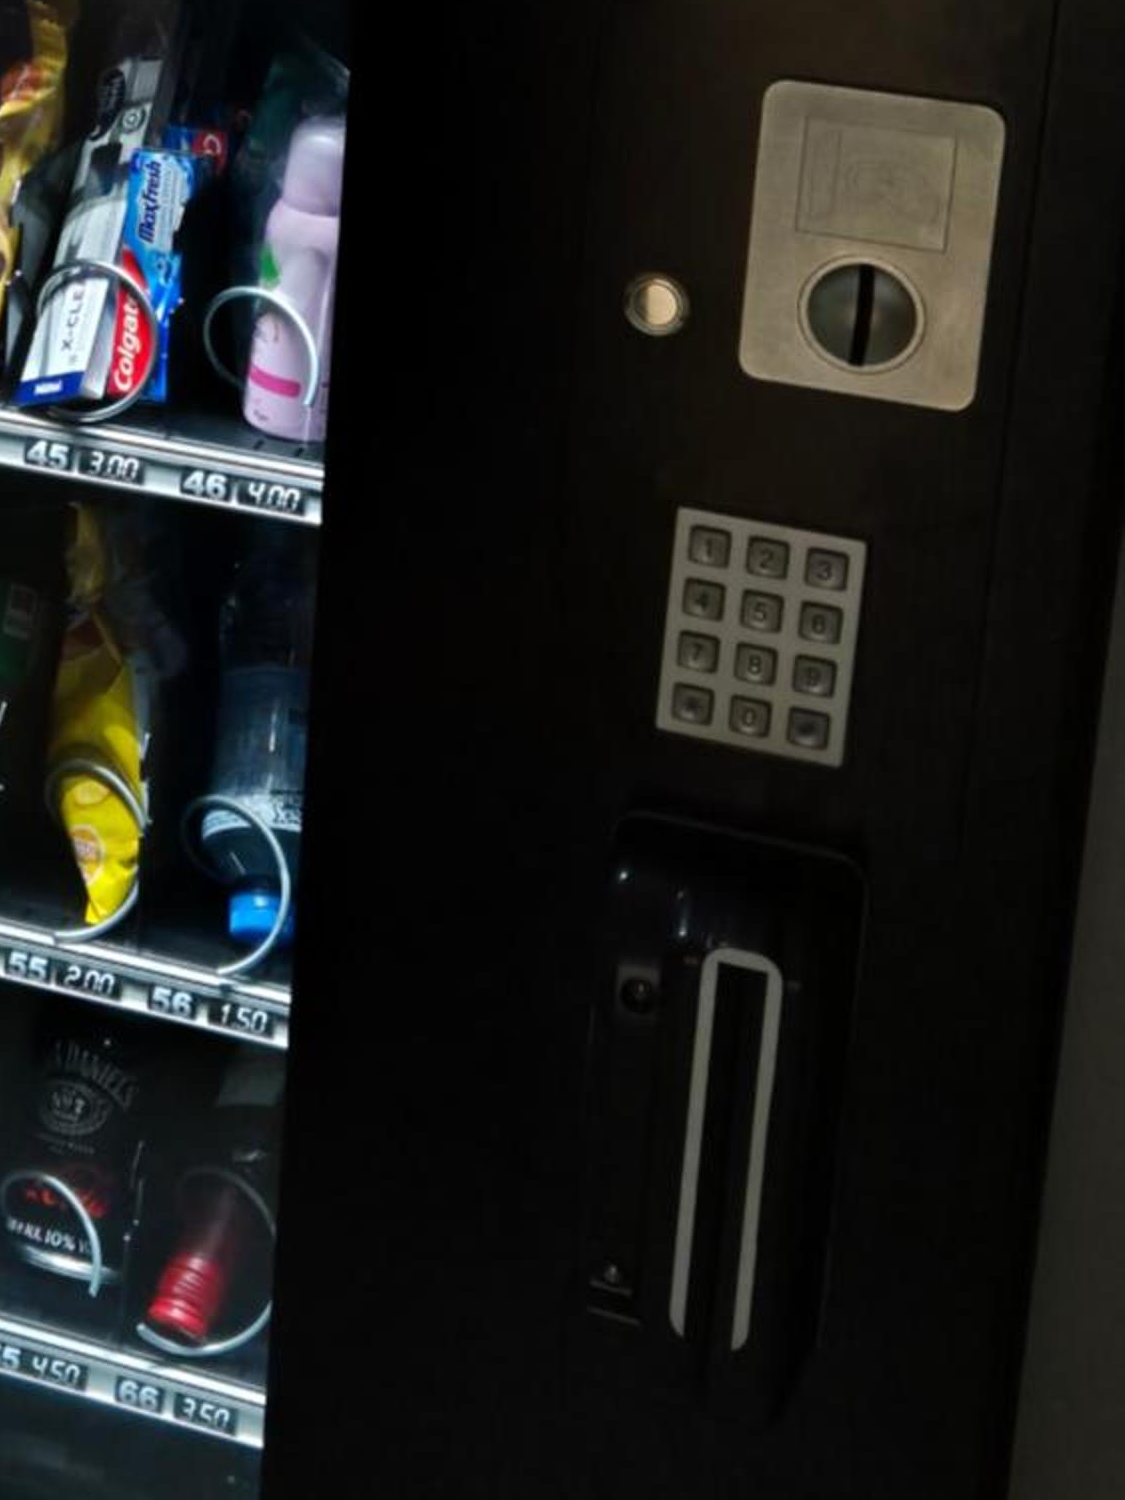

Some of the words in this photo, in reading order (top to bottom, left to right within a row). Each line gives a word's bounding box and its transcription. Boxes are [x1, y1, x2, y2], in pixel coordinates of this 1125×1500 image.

[26, 440, 71, 469] 45
[183, 469, 228, 500] 46
[9, 951, 48, 980] 55
[151, 987, 192, 1018] 56
[118, 1379, 161, 1409] 66
